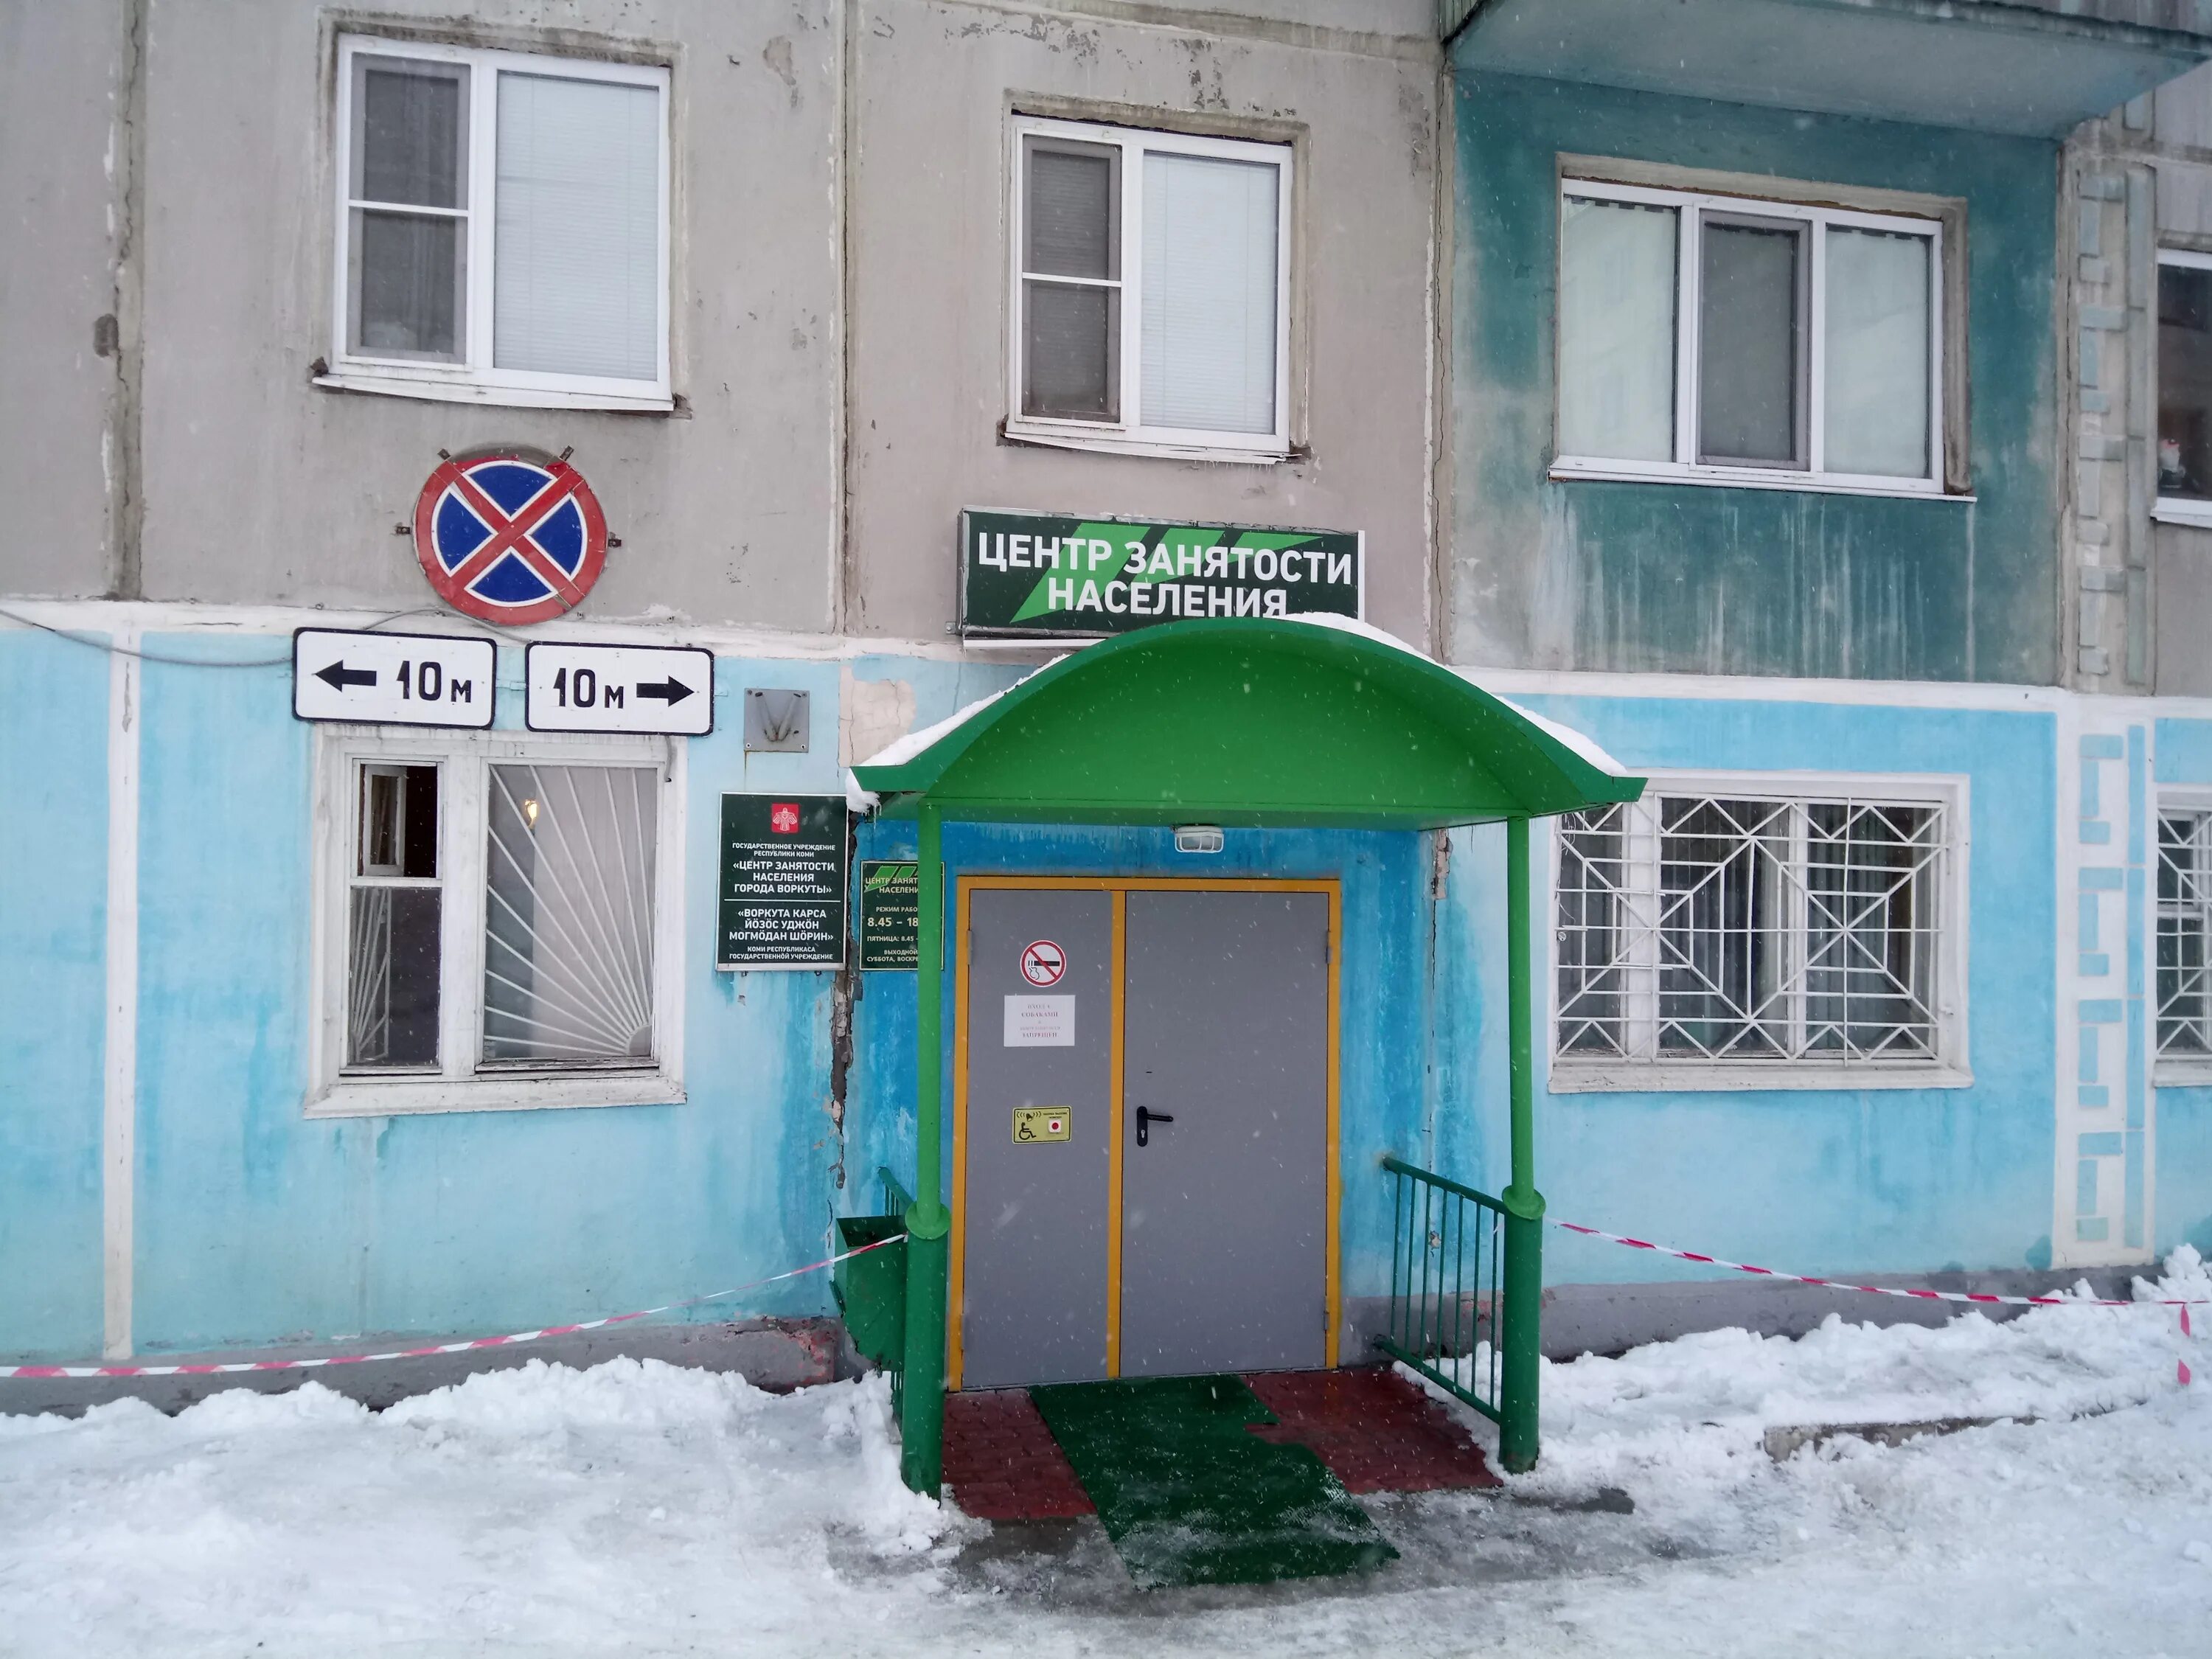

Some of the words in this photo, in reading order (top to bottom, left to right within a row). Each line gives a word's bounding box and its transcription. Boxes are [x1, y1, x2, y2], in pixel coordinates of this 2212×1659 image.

[978, 532, 1112, 572] ЦЕНТР
[1123, 541, 1352, 584] ЗАНЯТОСТИ
[1048, 577, 1287, 618] НАСЕЛЕНИЯ
[732, 842, 792, 850] ГОСУДАРСТВЕННОЕ
[733, 860, 773, 871] «ЦЕНТР
[775, 861, 835, 871] ЗАНЯТОСТИ
[753, 872, 815, 882] НАСЕЛЕНИЯ
[734, 883, 774, 894] ГОРОДА
[777, 885, 832, 894] ВОРКУТЫ»
[737, 908, 790, 918] «ВОРКУТА
[793, 909, 827, 918] КАРСА
[867, 917, 892, 927] 8.45
